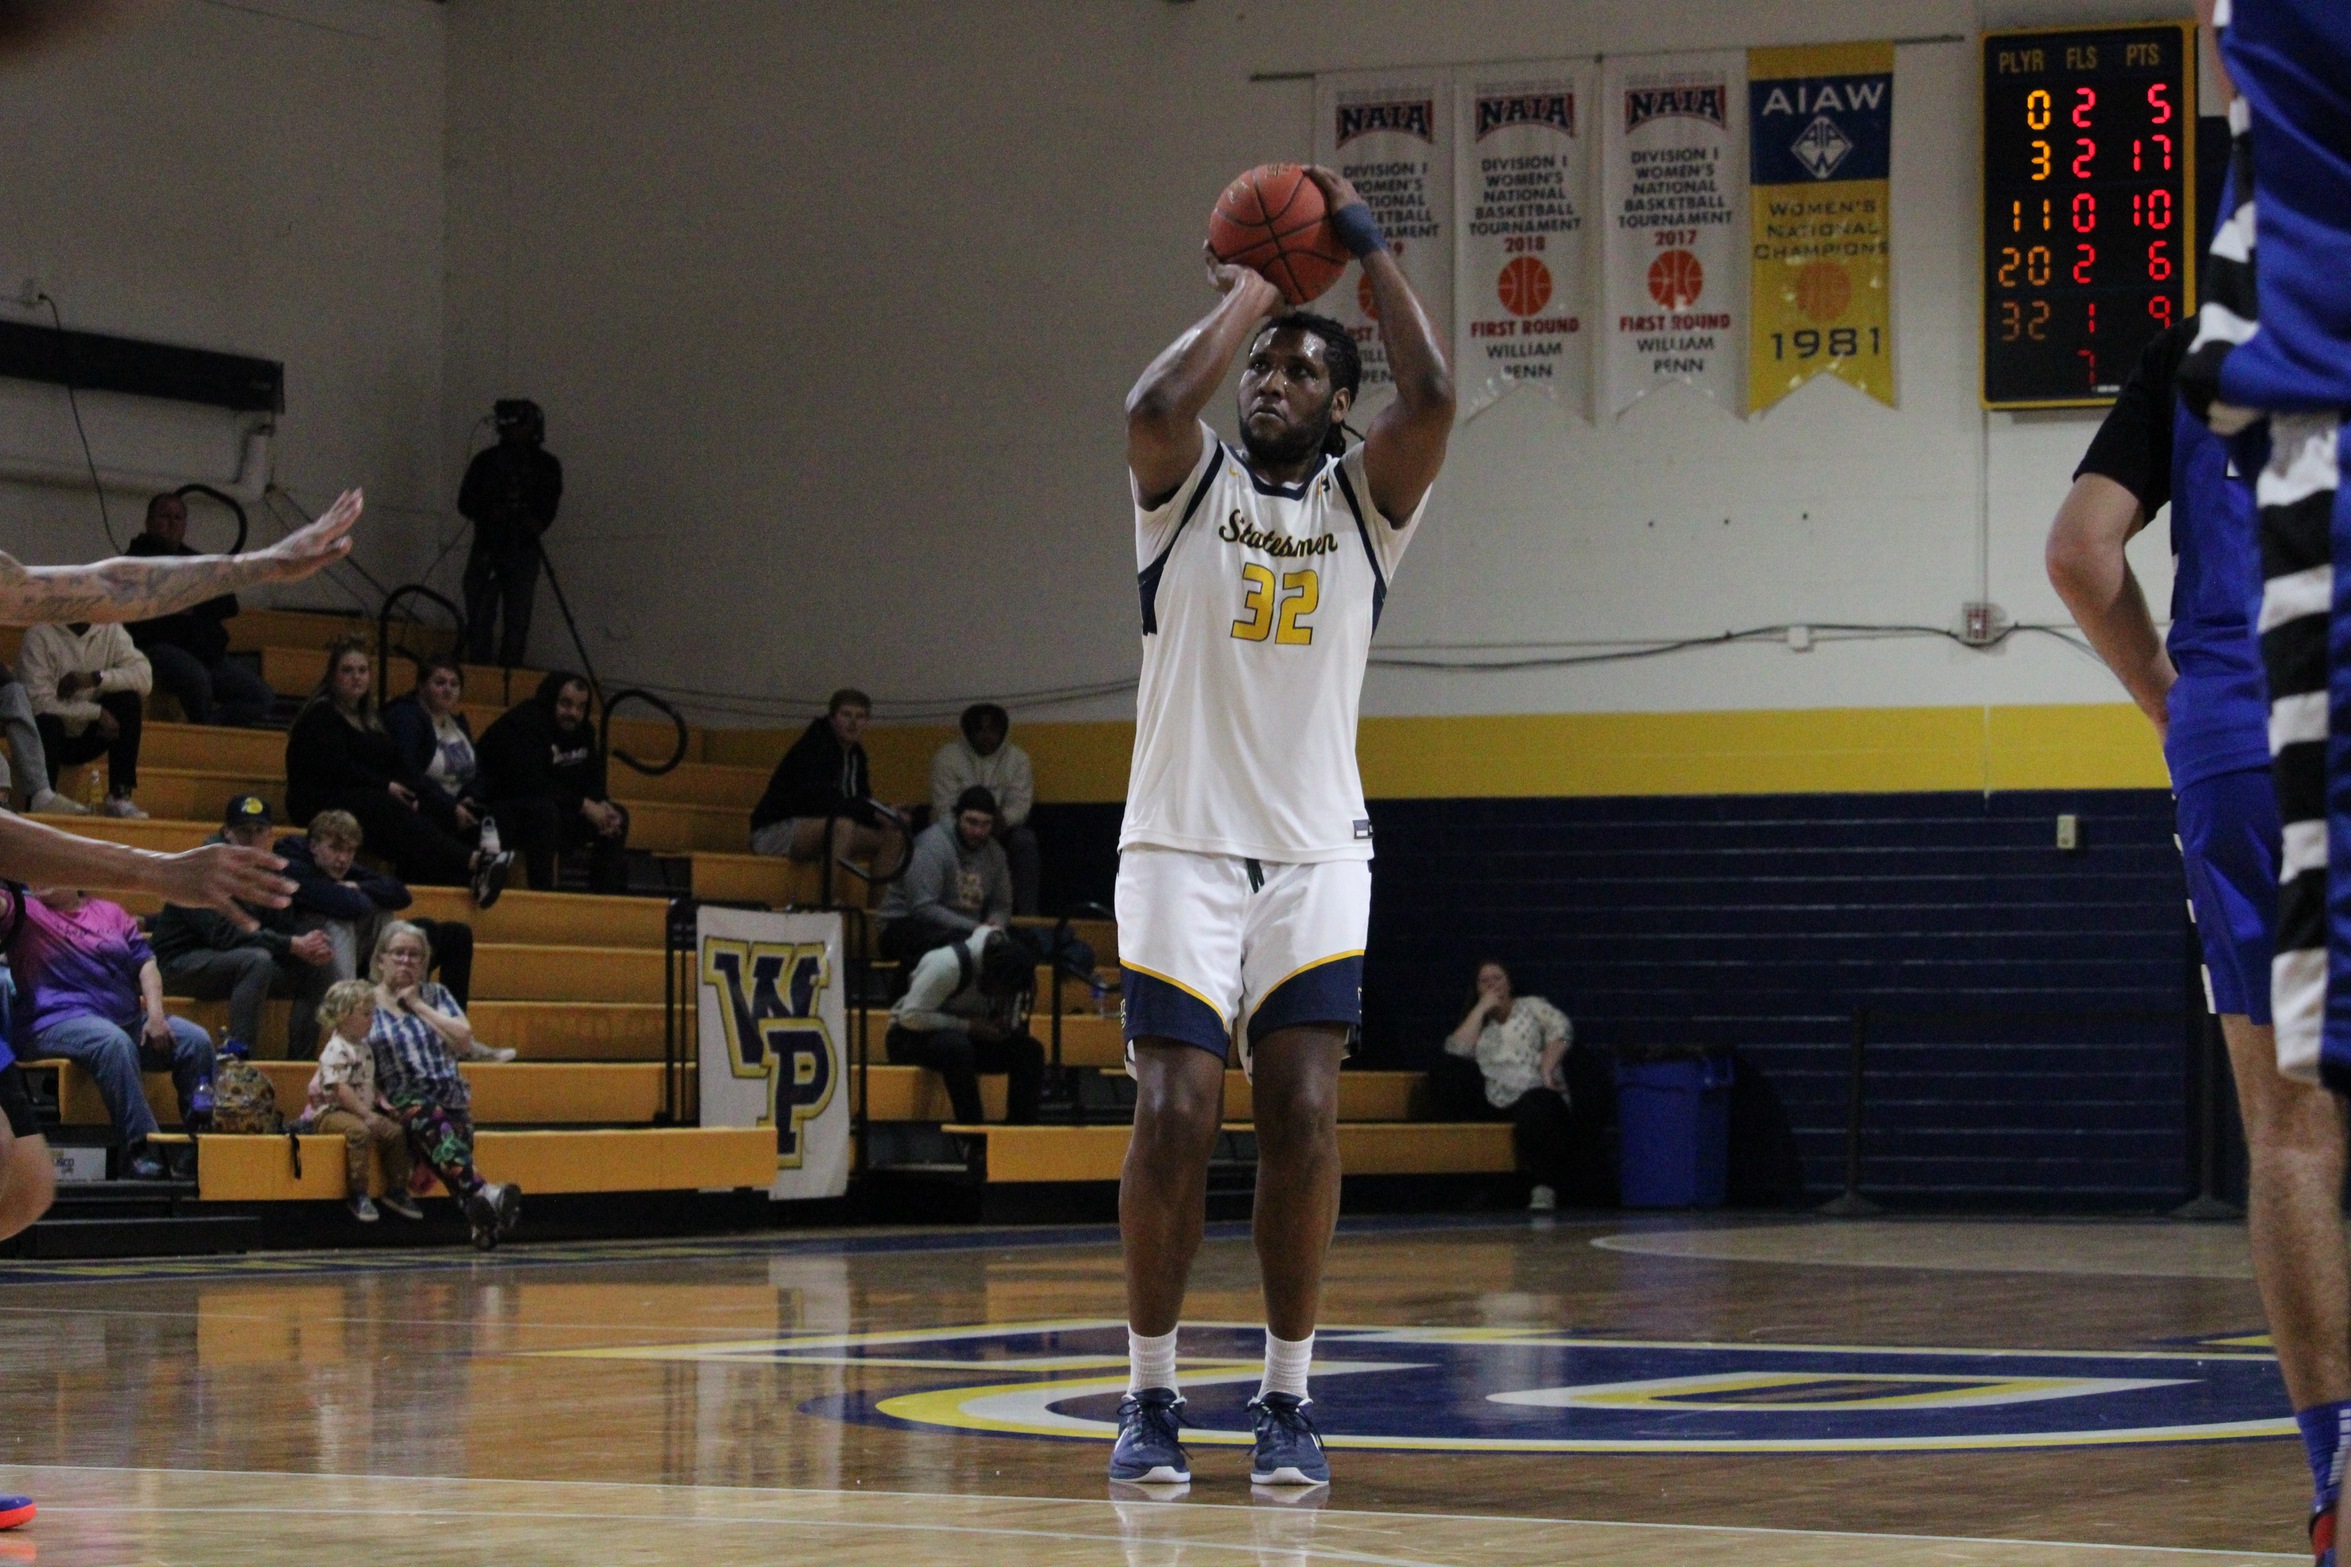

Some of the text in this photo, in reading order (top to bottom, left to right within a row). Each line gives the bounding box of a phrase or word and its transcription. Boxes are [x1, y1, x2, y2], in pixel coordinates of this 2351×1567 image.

[1999, 43, 2160, 73] PLYR FLS PTS
[1629, 88, 1721, 126] NAIA
[1762, 83, 1884, 116] AIAW
[2027, 82, 2171, 130] 0 2 5
[1339, 105, 1428, 141] NAIA
[1478, 97, 1570, 135] NAIA
[1481, 156, 1555, 172] DIVISION
[1631, 149, 1706, 165] DIVISION
[2030, 133, 2171, 181] 3 2 17
[1343, 163, 1415, 179] DIVISION
[1486, 172, 1564, 187] WOMEN'S
[1635, 163, 1714, 179] WOMEN'S
[1483, 187, 1566, 202] NATIONAL
[1632, 179, 1716, 195] NATIONAL
[1475, 203, 1574, 219] BASKETBALL
[1624, 196, 1725, 212] BASKETBALL
[2013, 188, 2171, 233] 11 0 10
[1469, 218, 1581, 236] TOURNAMENT
[1618, 210, 1732, 228] TOURNAMENT
[1655, 229, 1697, 246] 2017
[1999, 239, 2171, 287] 20 2 6
[1470, 317, 1580, 338] FIRST ROUND
[1619, 313, 1730, 332] FIRST ROUND
[2002, 299, 2051, 342] 32
[2088, 302, 2096, 334] 1
[1486, 342, 1562, 358] WILLIAM
[1637, 336, 1715, 353] WILLIAM
[1770, 326, 1881, 360] 1981
[1653, 358, 1704, 374] PENN
[1218, 508, 1338, 558] Statesmen
[1230, 561, 1320, 646] 32
